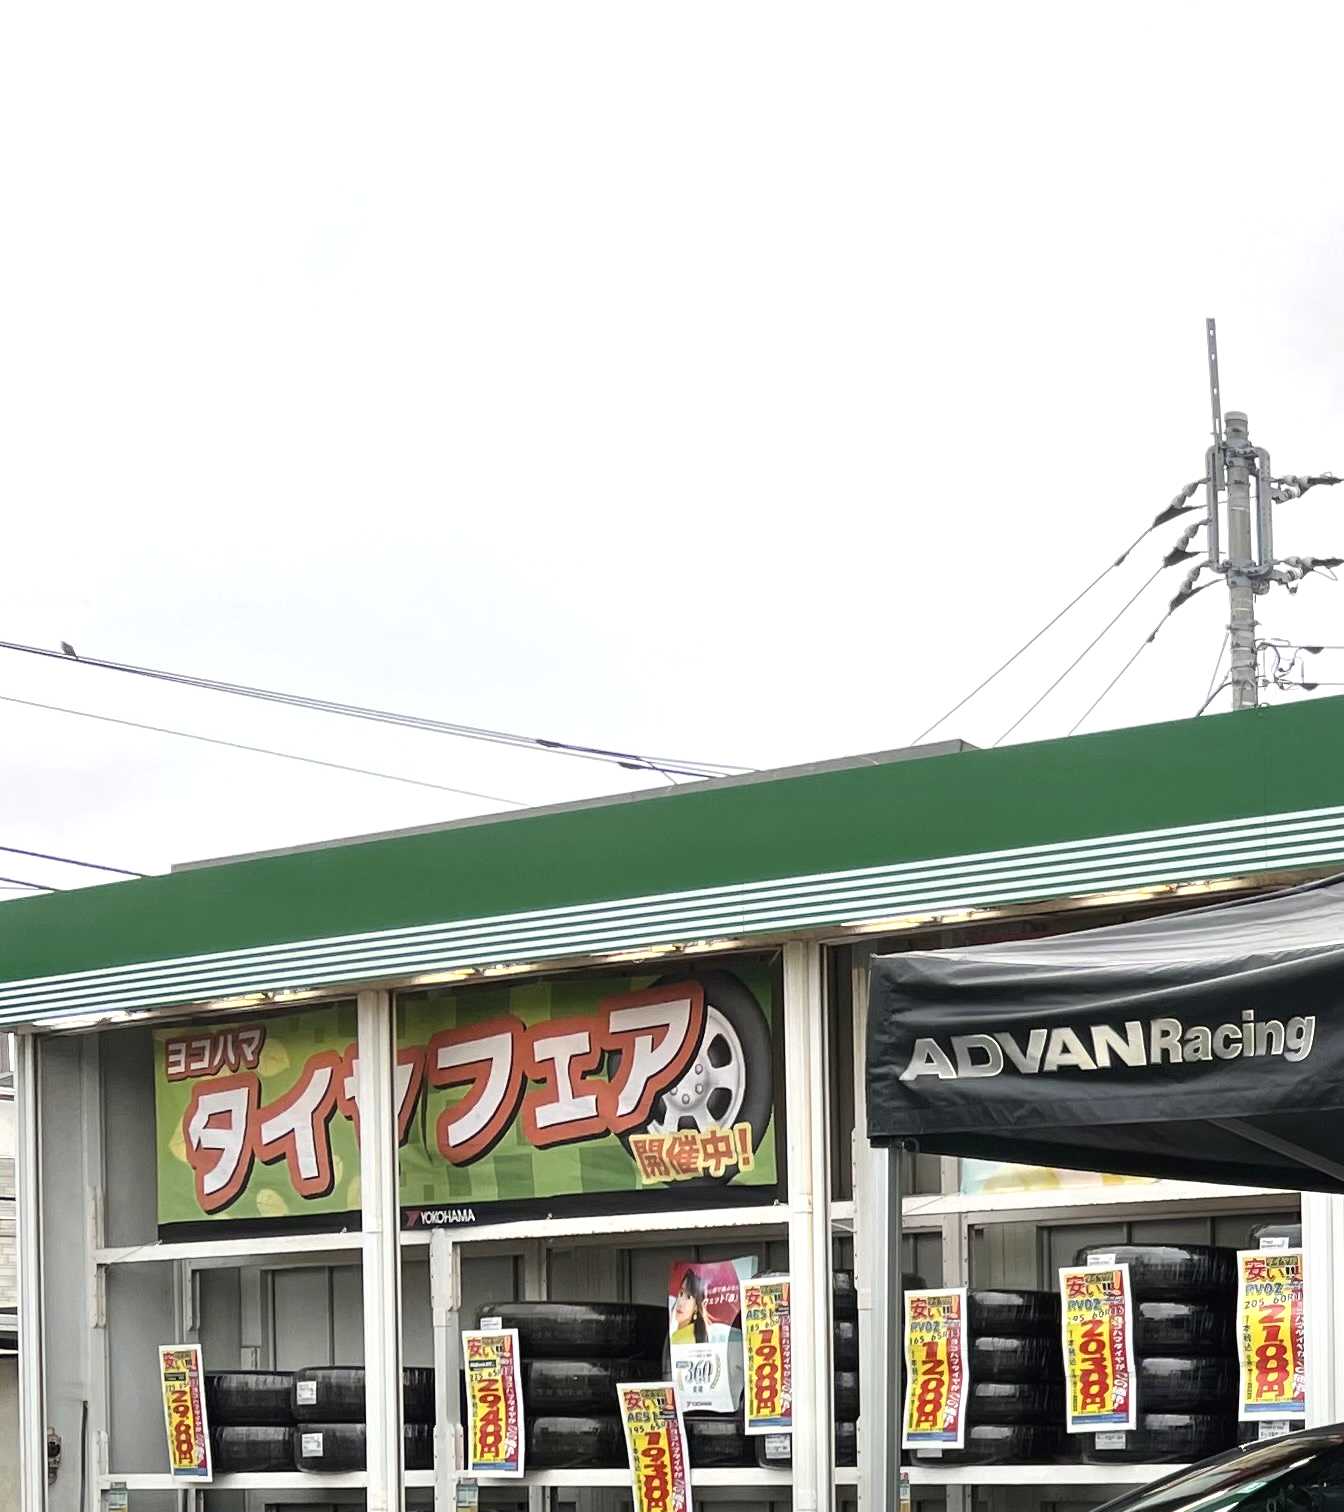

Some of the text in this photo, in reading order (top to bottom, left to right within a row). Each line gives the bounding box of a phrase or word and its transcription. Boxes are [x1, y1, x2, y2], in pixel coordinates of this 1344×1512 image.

[166, 1027, 263, 1076] ヨコハマ
[420, 1207, 476, 1227] YOKOHAMA
